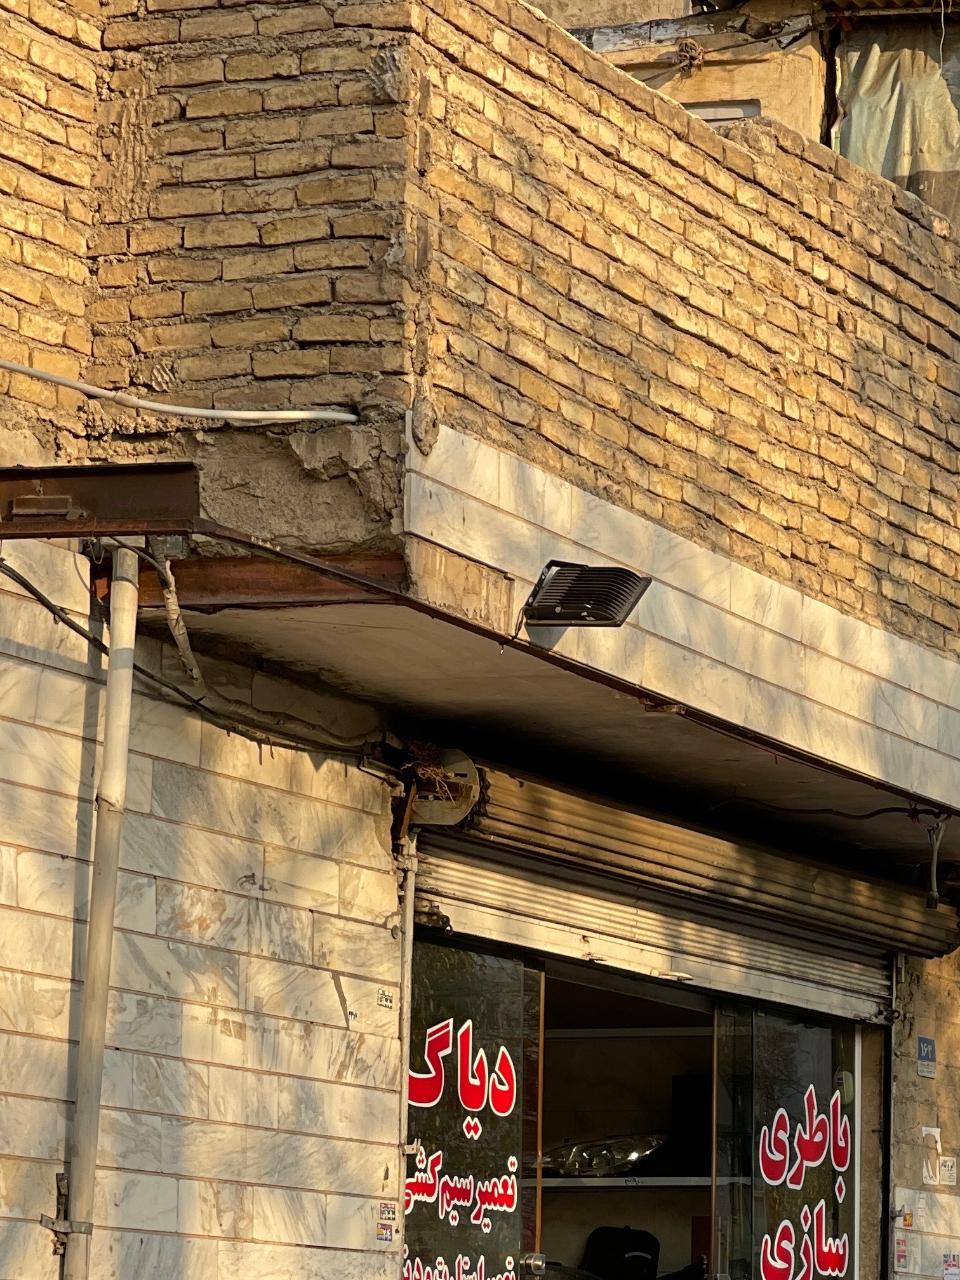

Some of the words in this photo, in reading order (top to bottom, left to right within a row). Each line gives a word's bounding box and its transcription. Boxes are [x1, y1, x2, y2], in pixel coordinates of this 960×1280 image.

[407, 1018, 517, 1140] دیاگ
[759, 1084, 851, 1203] باطری
[439, 1174, 474, 1226] سیم
[470, 1155, 518, 1234] تعمیر
